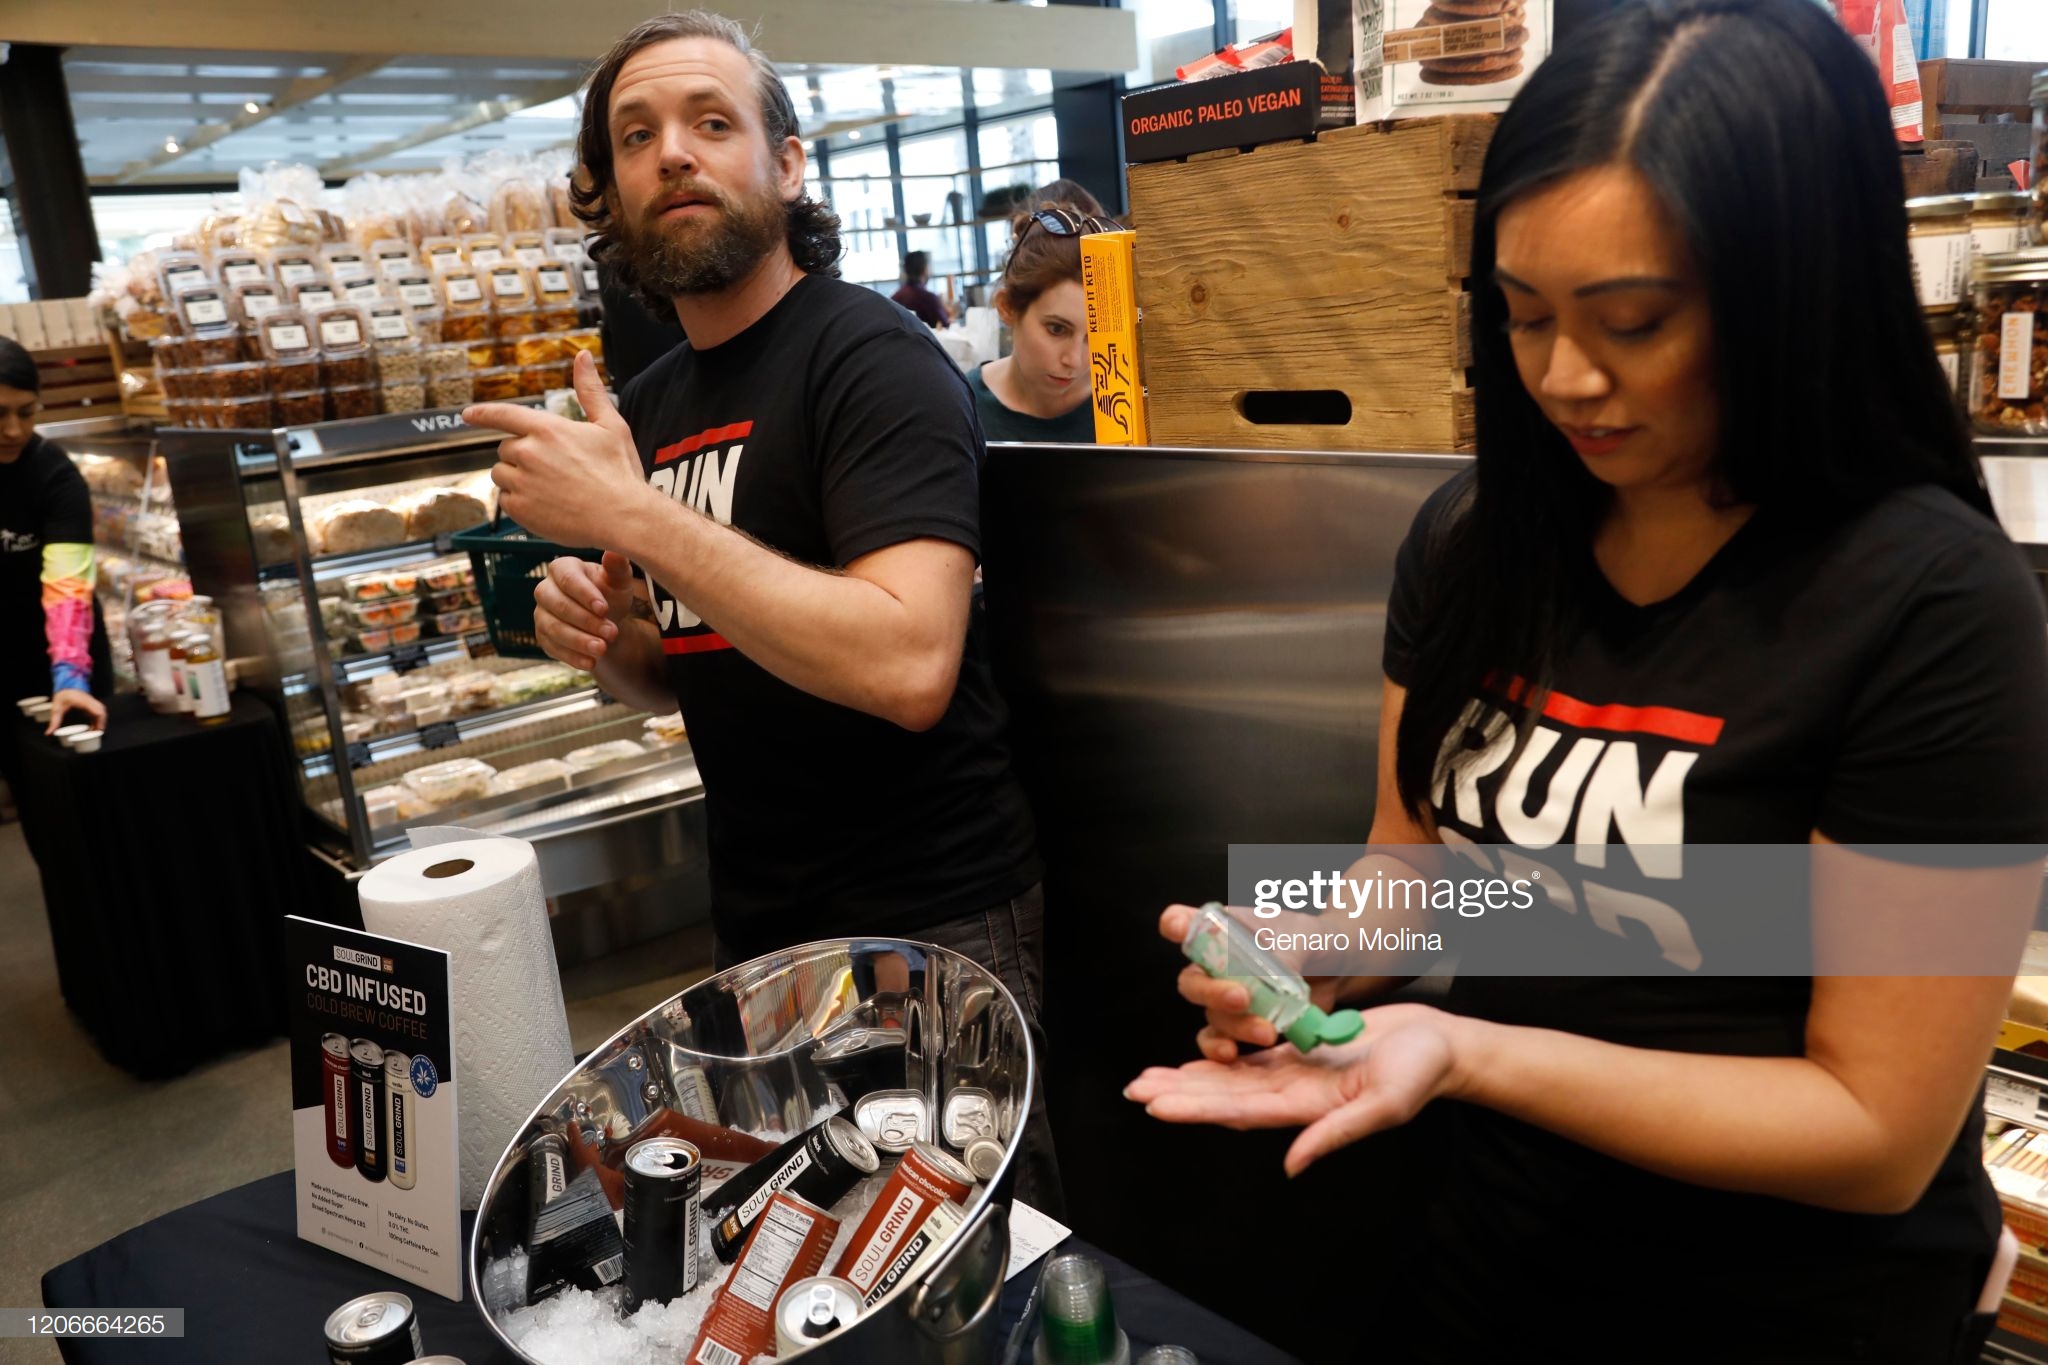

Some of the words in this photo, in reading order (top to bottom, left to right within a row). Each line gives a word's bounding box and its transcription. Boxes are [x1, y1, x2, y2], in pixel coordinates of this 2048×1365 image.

[1131, 108, 1193, 135] ORGANIC
[1198, 100, 1243, 123] PALEO
[1247, 88, 1301, 113] VEGAN
[1083, 255, 1093, 287] KETO
[1086, 290, 1095, 301] IT
[1088, 304, 1098, 333] KEEP
[411, 412, 466, 433] WRA
[1432, 698, 1699, 879] RUN
[336, 947, 379, 968] SOULGRIND
[306, 963, 342, 994] CBD
[346, 973, 427, 1016] INFUSED
[307, 992, 338, 1014] COLD
[340, 1000, 376, 1025] BREW
[378, 1011, 428, 1040] COFFEE
[552, 1157, 562, 1193] GRIND
[741, 1153, 804, 1219] SOULGRIND
[919, 1176, 951, 1200] chocolate
[688, 1200, 698, 1285] SOULGRIND
[855, 1196, 914, 1282] SOULGRIND
[865, 1237, 924, 1310] OULGRIND
